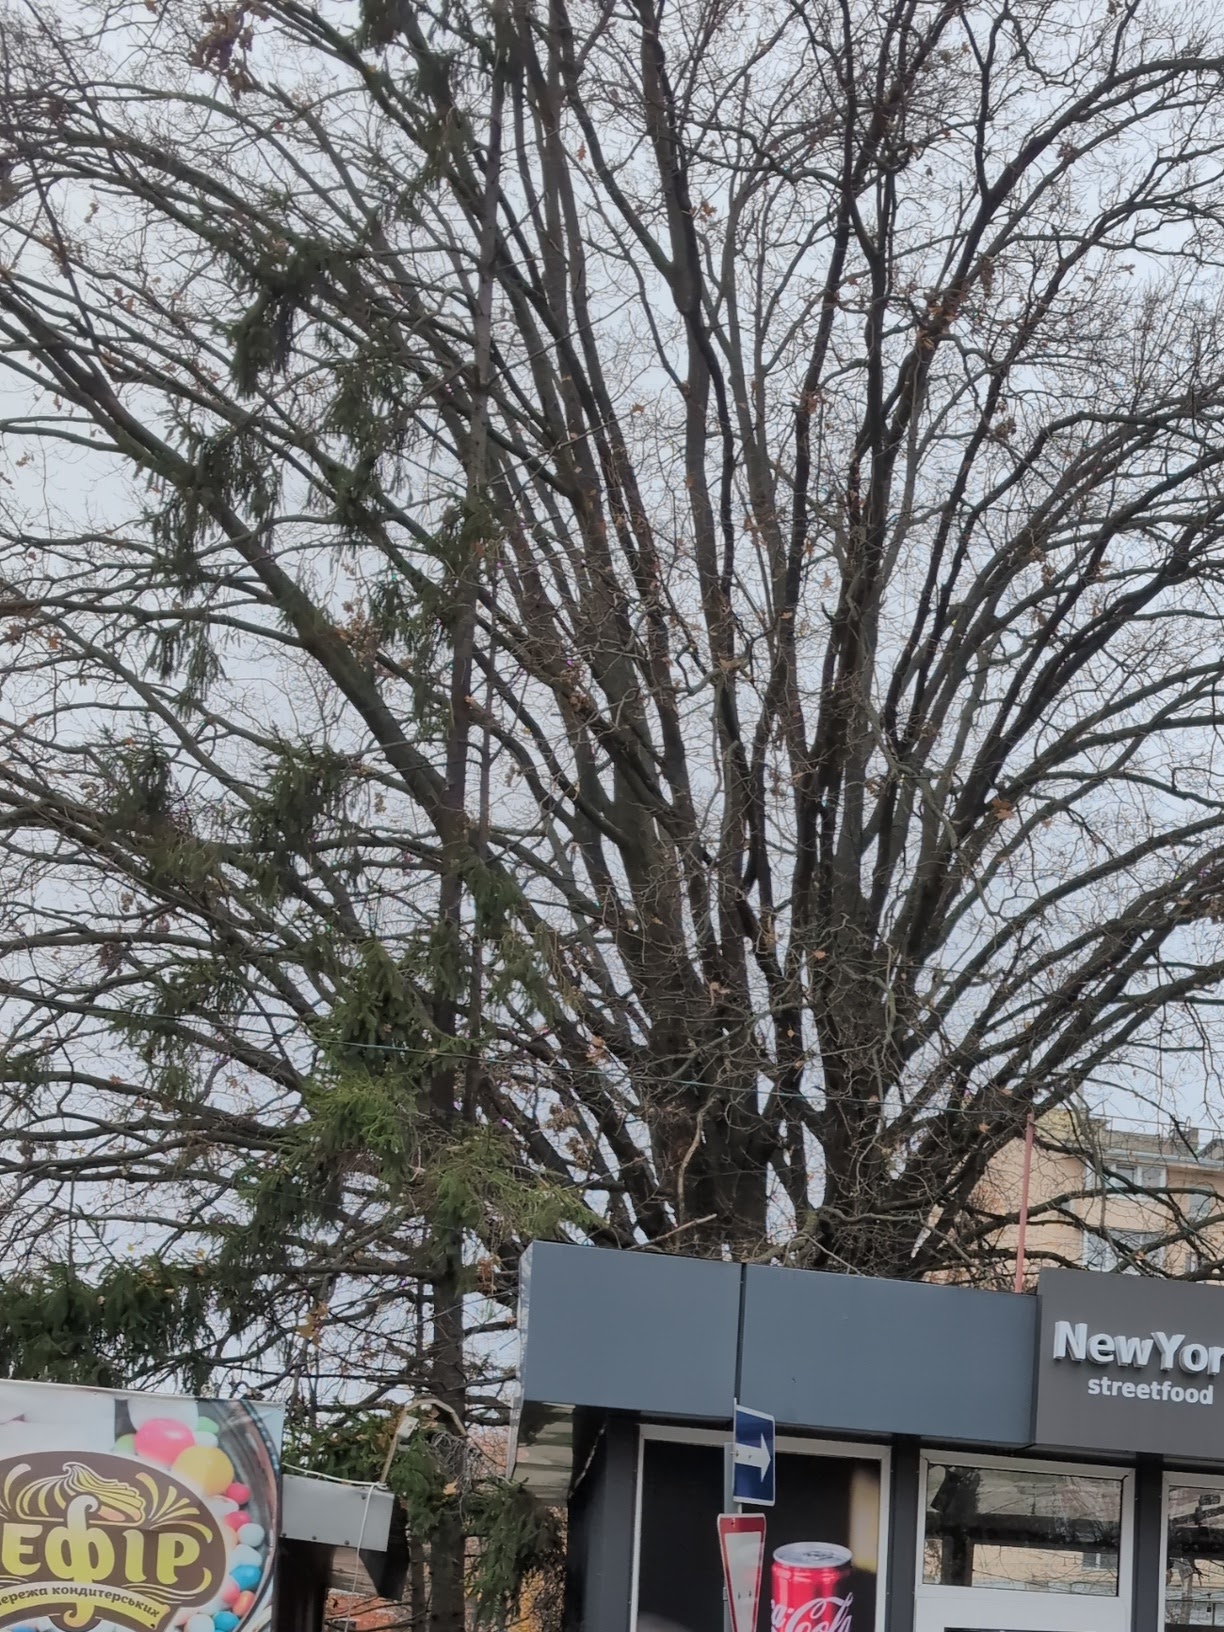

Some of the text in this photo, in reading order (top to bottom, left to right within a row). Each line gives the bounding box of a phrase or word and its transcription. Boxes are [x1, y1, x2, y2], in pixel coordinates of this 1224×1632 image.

[1087, 1376, 1213, 1405] streetfood
[0, 1585, 161, 1618] ережа кондитерських
